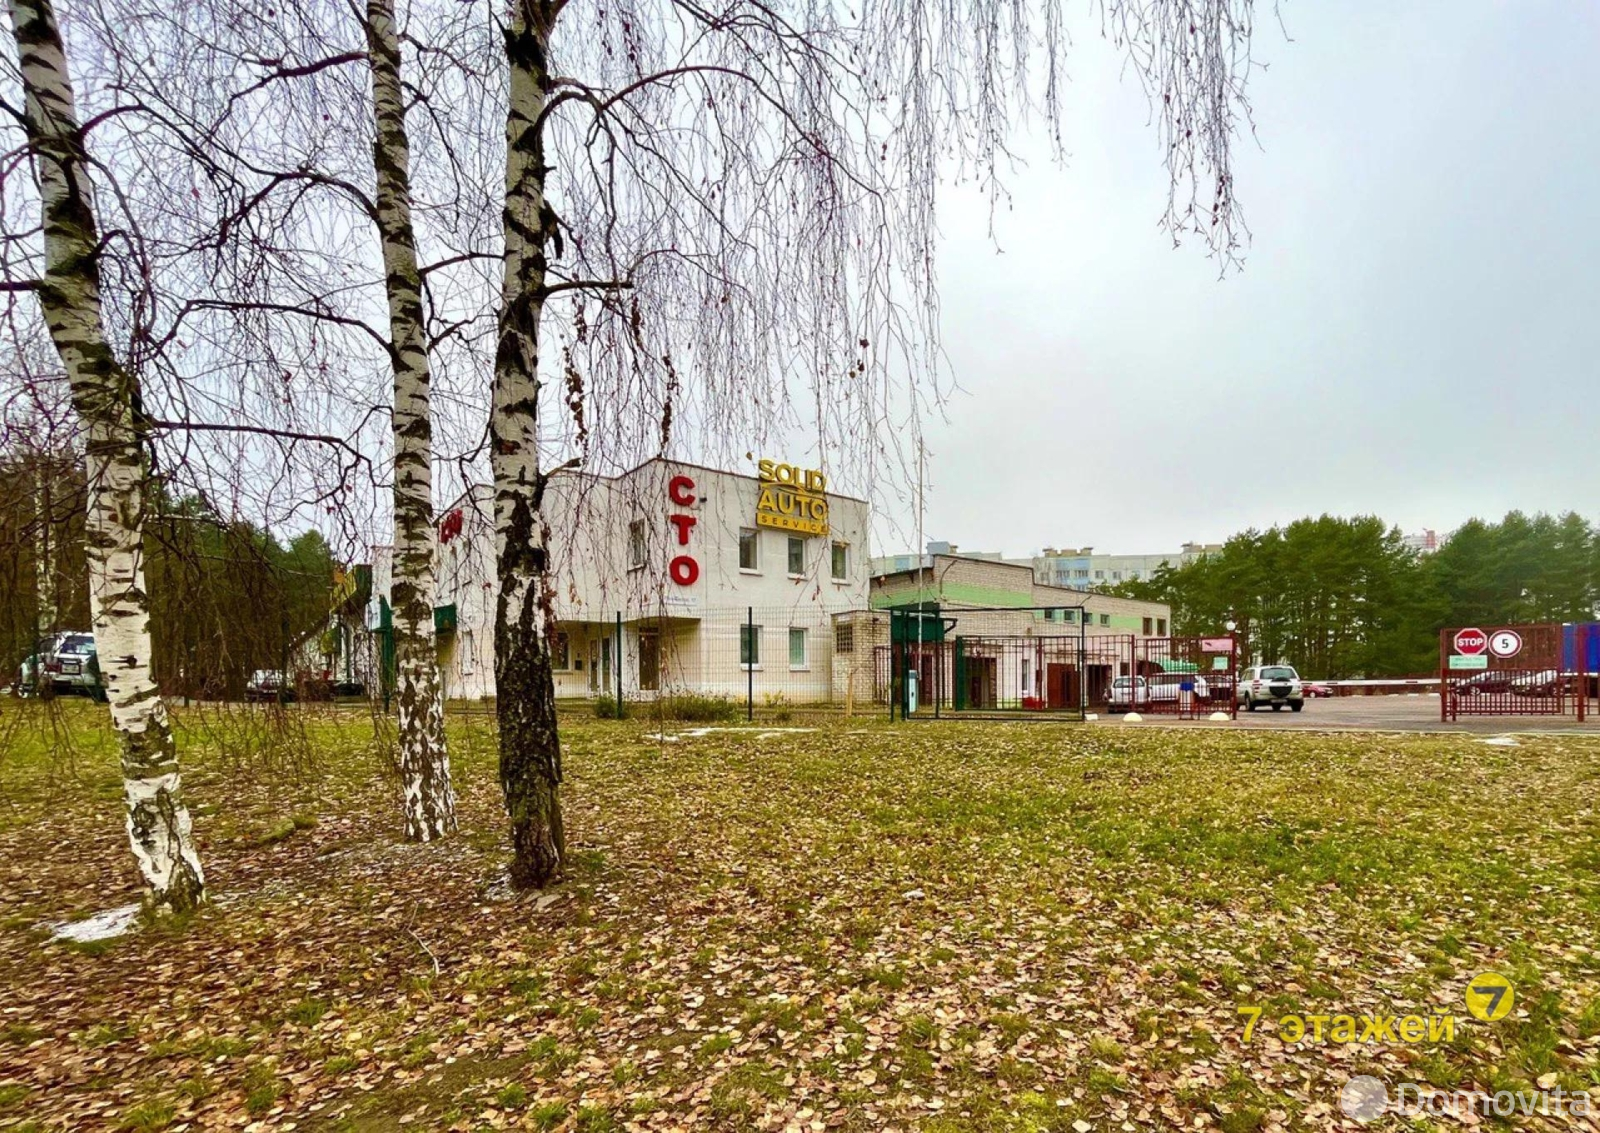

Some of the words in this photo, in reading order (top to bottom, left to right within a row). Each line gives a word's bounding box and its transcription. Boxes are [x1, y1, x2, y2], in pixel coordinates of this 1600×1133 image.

[759, 459, 826, 491] SOLID
[757, 489, 828, 520] AUTO
[669, 475, 699, 586] СТО
[1458, 637, 1483, 647] STOP
[1501, 638, 1509, 649] 5
